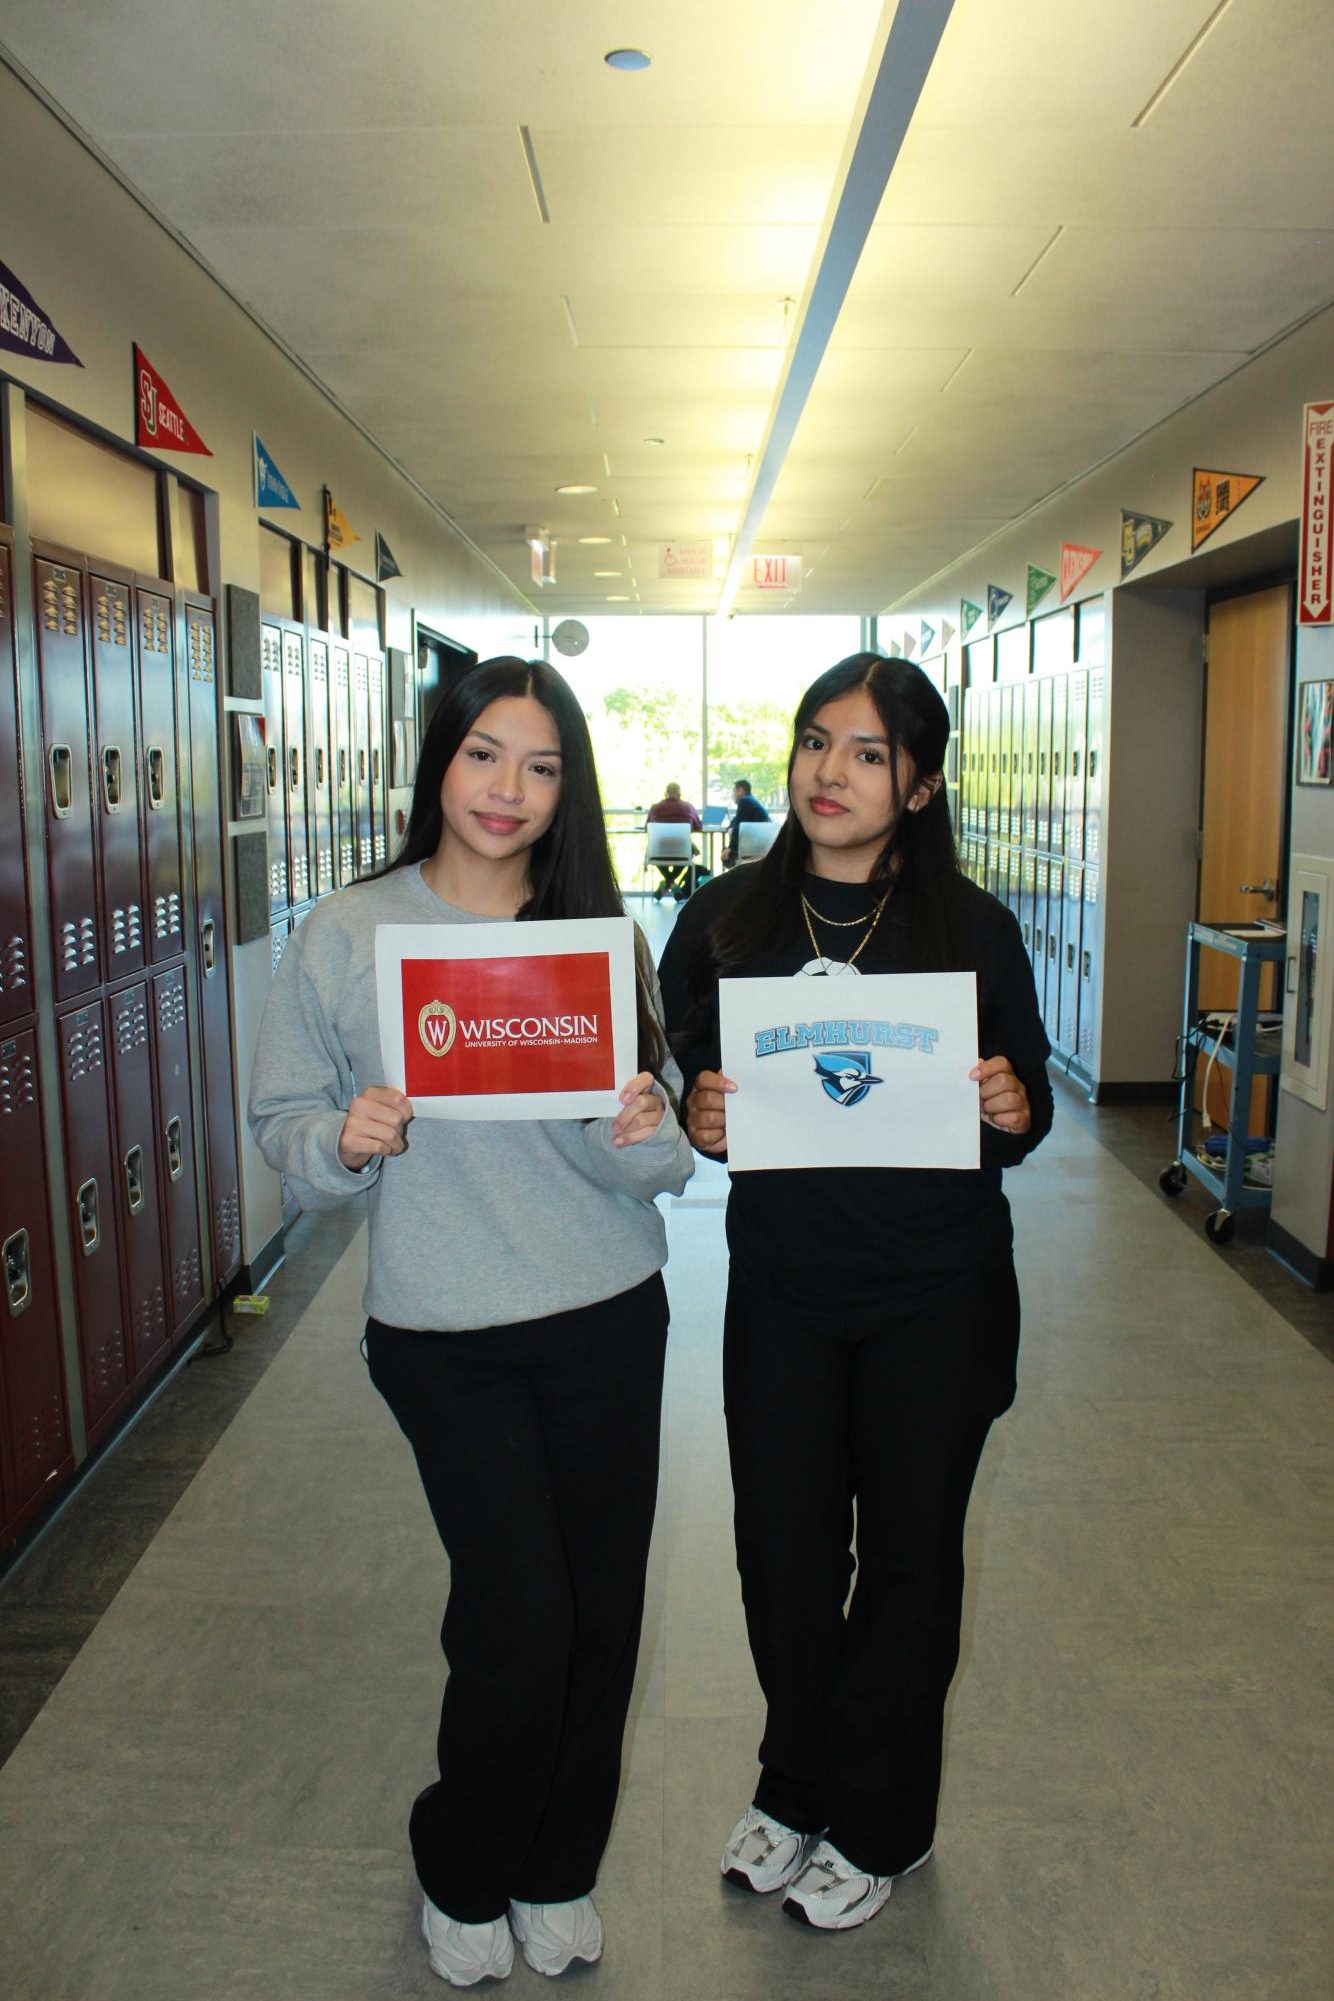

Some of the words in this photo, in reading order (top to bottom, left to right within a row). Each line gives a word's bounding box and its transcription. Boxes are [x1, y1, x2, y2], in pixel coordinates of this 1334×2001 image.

[0, 283, 56, 356] KENYON
[159, 401, 185, 443] SEATTLE
[1310, 421, 1333, 435] FIRE
[1311, 438, 1325, 604] EXTINGUISHER
[754, 558, 787, 582] EXIT
[427, 1019, 447, 1046] W
[459, 1015, 598, 1039] WISCONSIN
[755, 1019, 939, 1058] ELMHURST
[465, 1039, 506, 1048] UNIVERSITY
[509, 1038, 518, 1047] OF
[520, 1037, 598, 1047] WISCONSIN-MADISON
